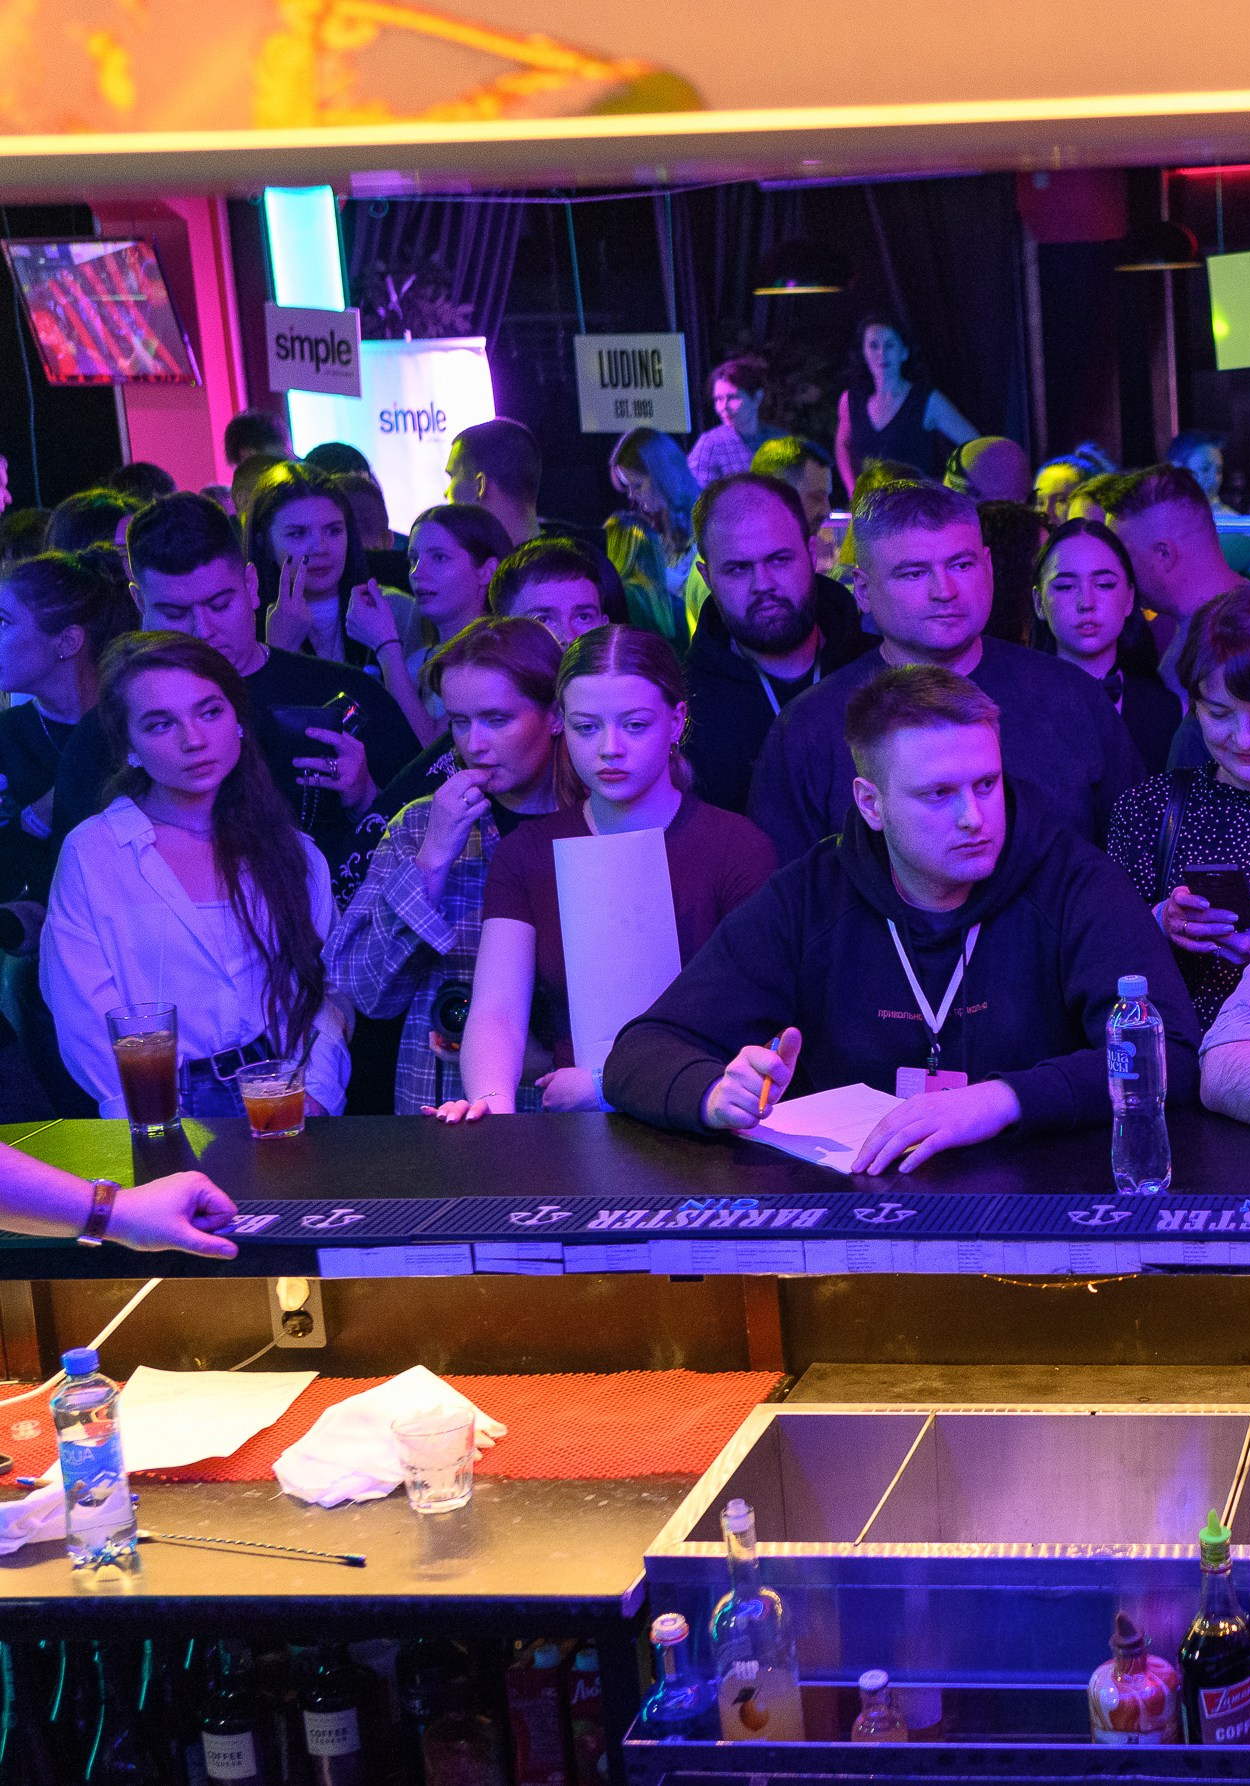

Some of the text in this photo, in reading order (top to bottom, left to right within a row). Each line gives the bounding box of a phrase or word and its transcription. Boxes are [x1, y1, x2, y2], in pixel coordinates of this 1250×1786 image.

[275, 325, 352, 373] simple
[598, 349, 664, 389] LUDING
[379, 402, 447, 442] simple
[877, 1009, 923, 1021] прикольно
[678, 1198, 759, 1211] GIN
[587, 1208, 828, 1230] BARRISTER
[309, 1727, 348, 1738] COFFEE
[207, 1751, 243, 1761] COFFEE
